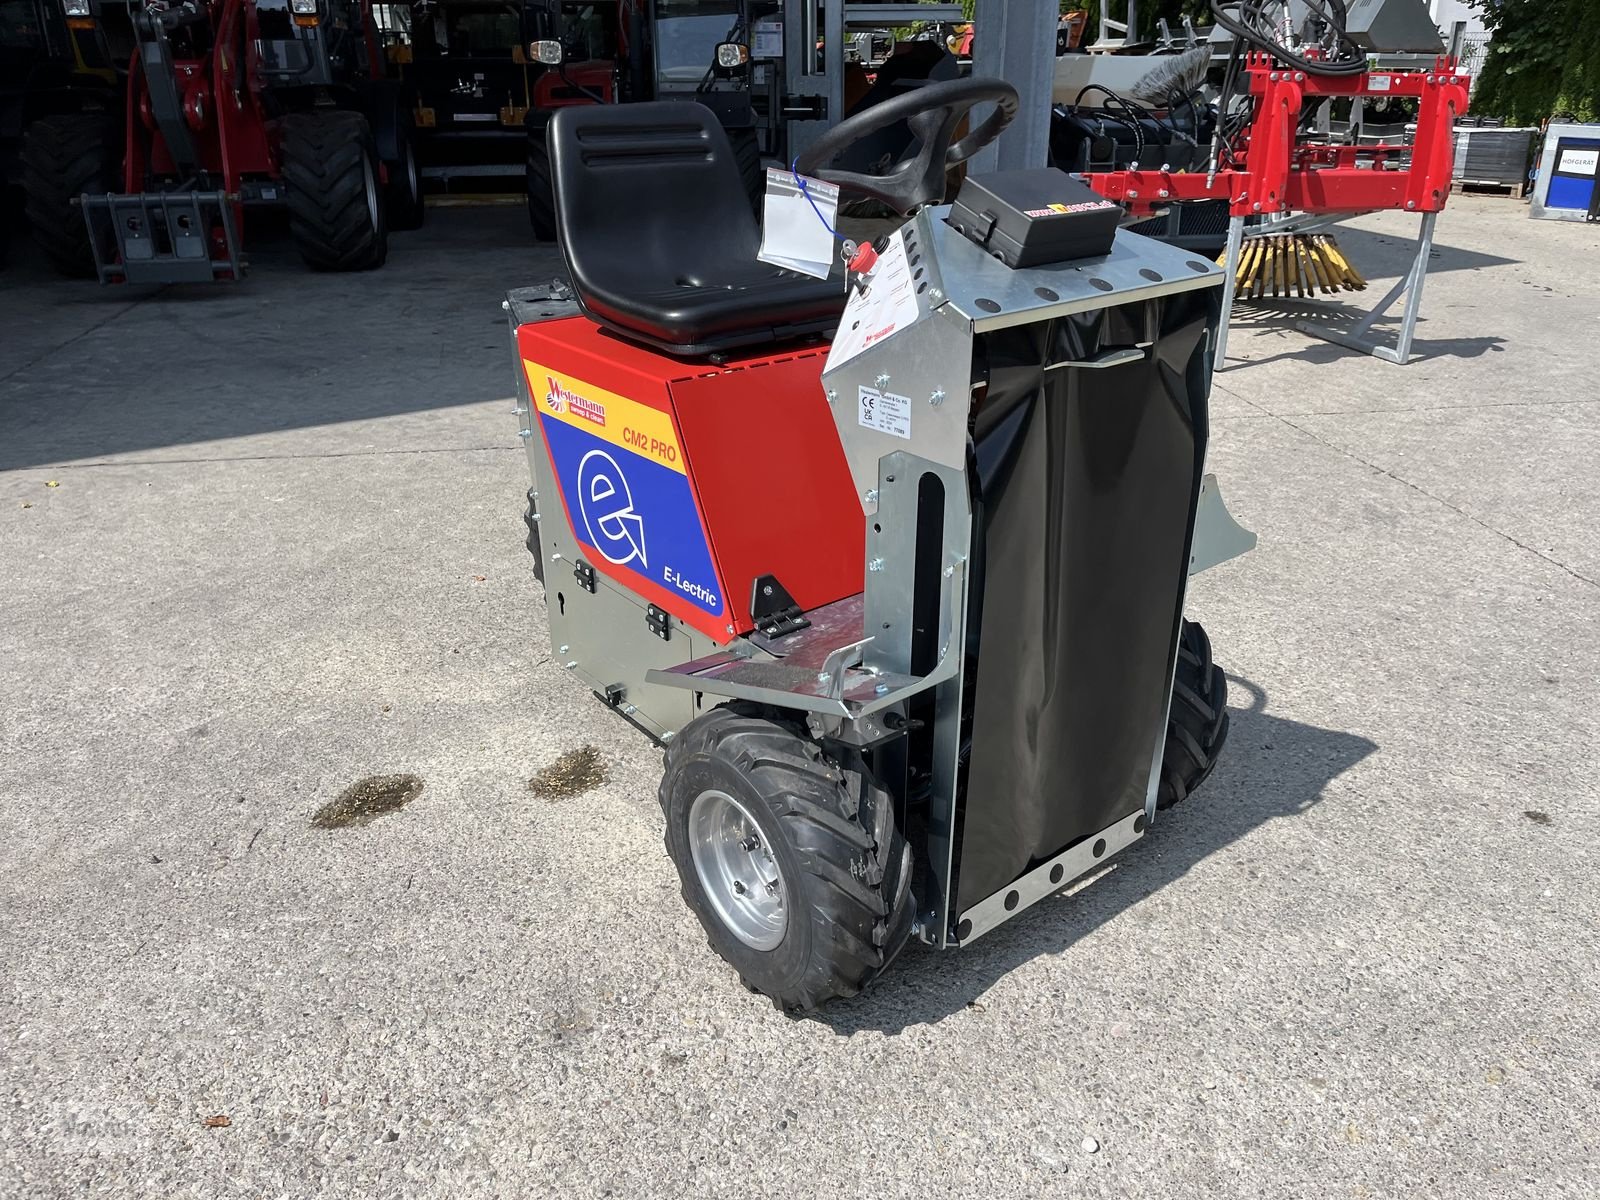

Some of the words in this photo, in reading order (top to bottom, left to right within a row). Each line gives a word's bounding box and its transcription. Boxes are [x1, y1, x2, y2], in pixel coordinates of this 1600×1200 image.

[547, 376, 605, 415] Westermann
[622, 427, 648, 451] CM2
[651, 440, 676, 462] PRO
[663, 566, 717, 607] E-Lectric
